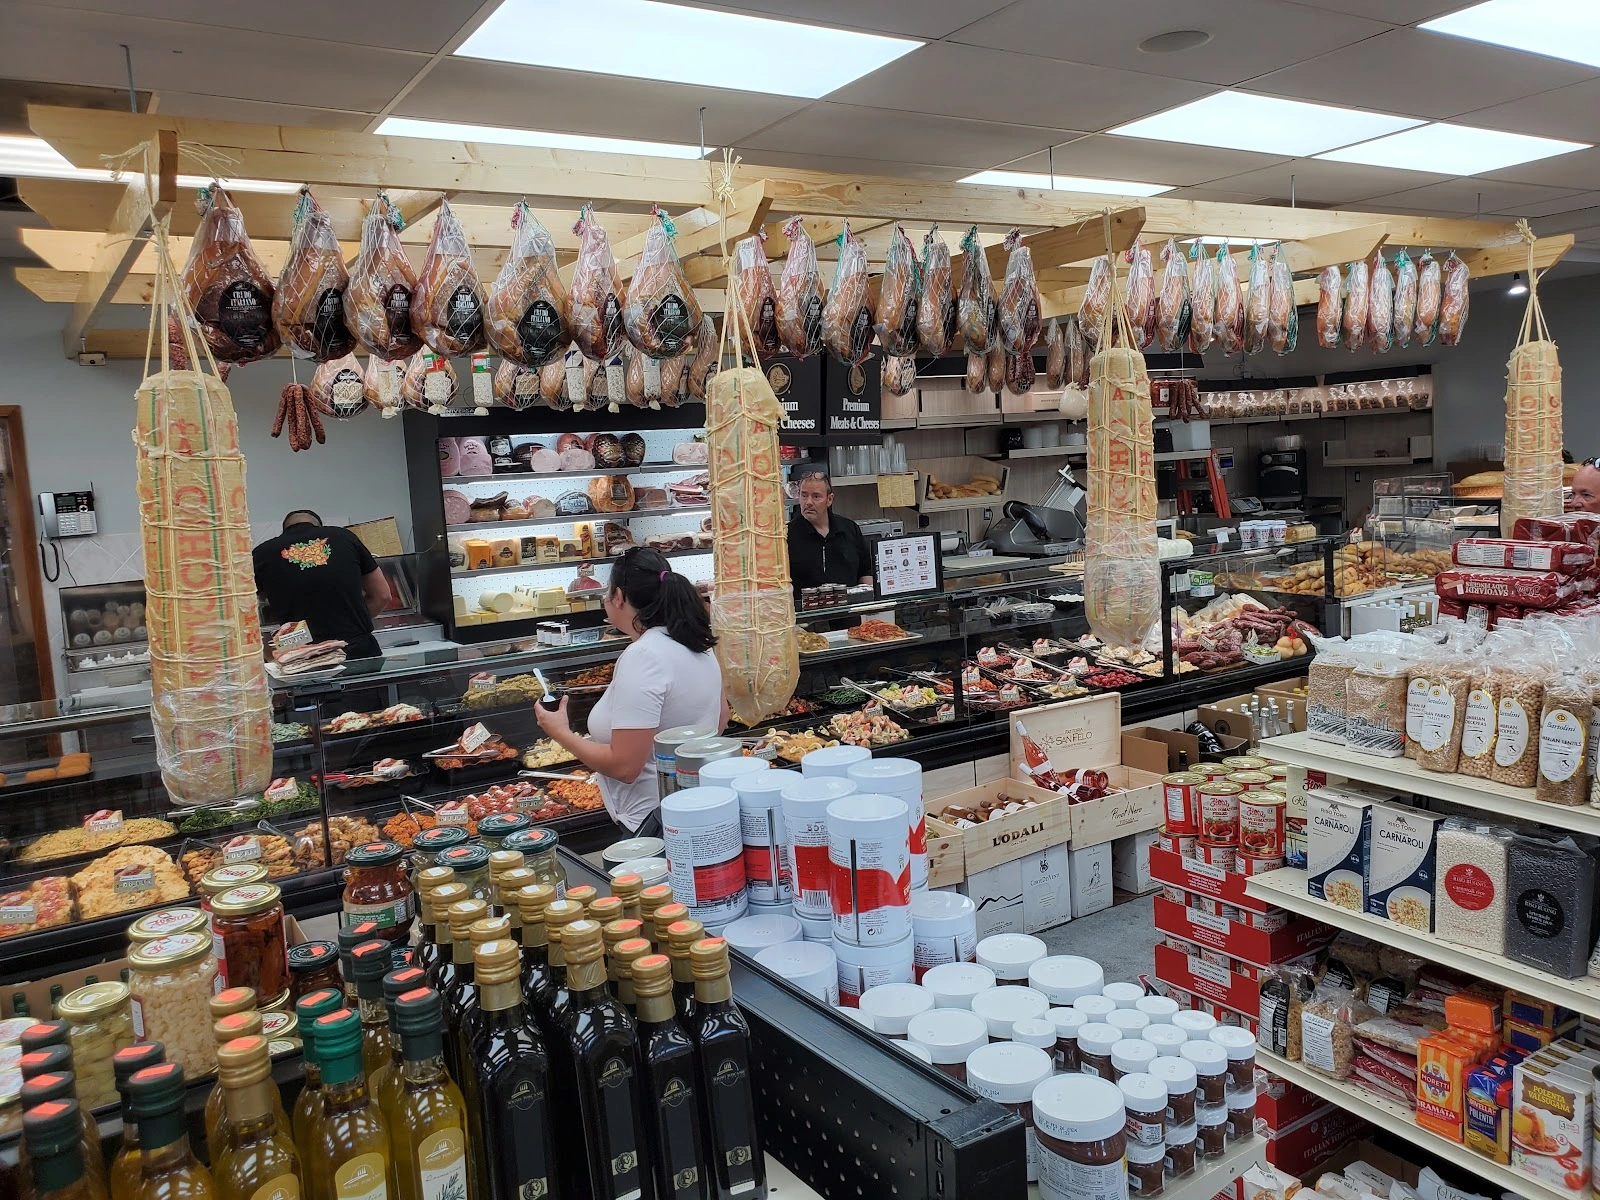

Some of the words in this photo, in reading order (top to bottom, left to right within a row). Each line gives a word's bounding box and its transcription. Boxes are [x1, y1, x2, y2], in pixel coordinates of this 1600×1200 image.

[842, 398, 870, 412] Premium
[780, 416, 816, 430] Cheeses
[830, 416, 850, 430] Meats
[850, 416, 857, 430] &
[857, 416, 880, 430] Cheeses
[1466, 586, 1508, 597] SAVOIARDI
[1546, 722, 1577, 732] Bartolini
[1320, 807, 1332, 816] RISO
[1314, 816, 1355, 835] CARNAROLI
[1387, 820, 1400, 830] RISO
[1401, 824, 1417, 833] TORO
[1379, 829, 1424, 850] CARNAROLI
[1421, 1073, 1450, 1090] MORETTI
[1533, 1085, 1566, 1103] POLENTA
[1528, 1090, 1570, 1113] VALSUGANA
[1470, 1108, 1494, 1126] POLENTA
[1126, 1119, 1142, 1131] tella
